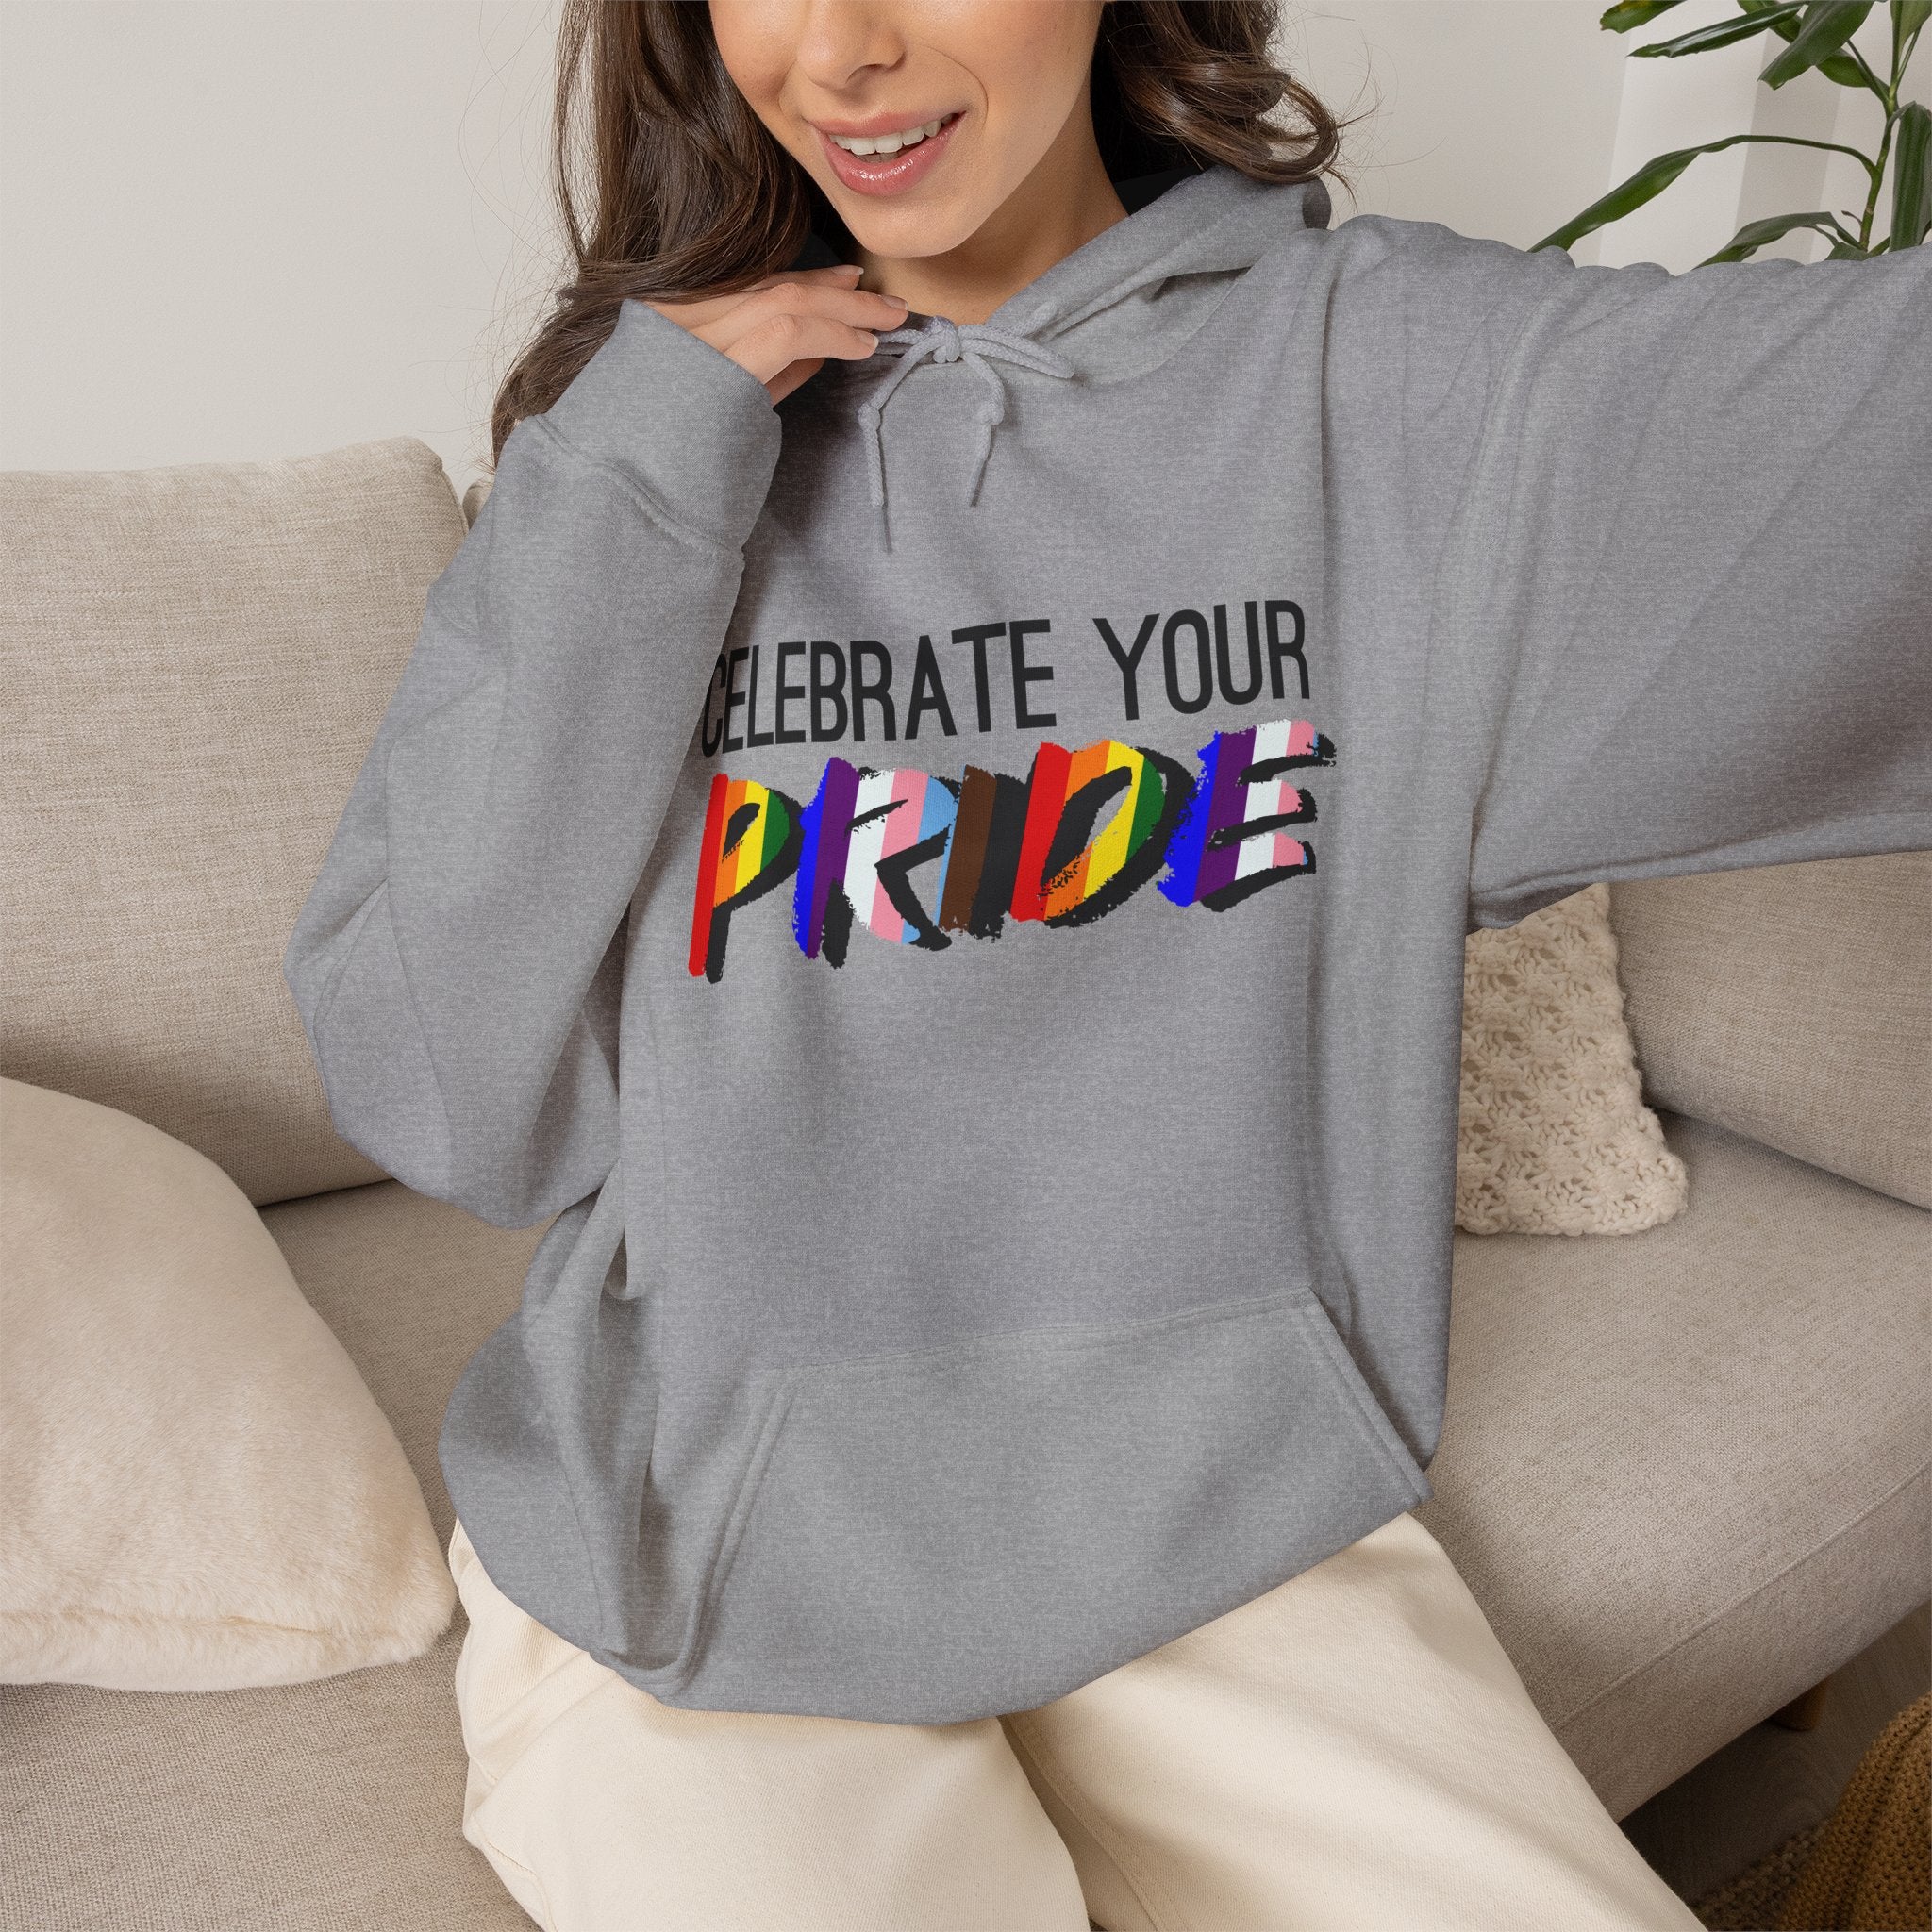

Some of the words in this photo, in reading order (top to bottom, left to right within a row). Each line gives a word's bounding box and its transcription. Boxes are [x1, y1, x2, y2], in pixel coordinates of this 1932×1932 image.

[702, 619, 1057, 758] CELEBRATE
[1092, 600, 1310, 720] YOUR
[688, 719, 1337, 984] PRIDE
